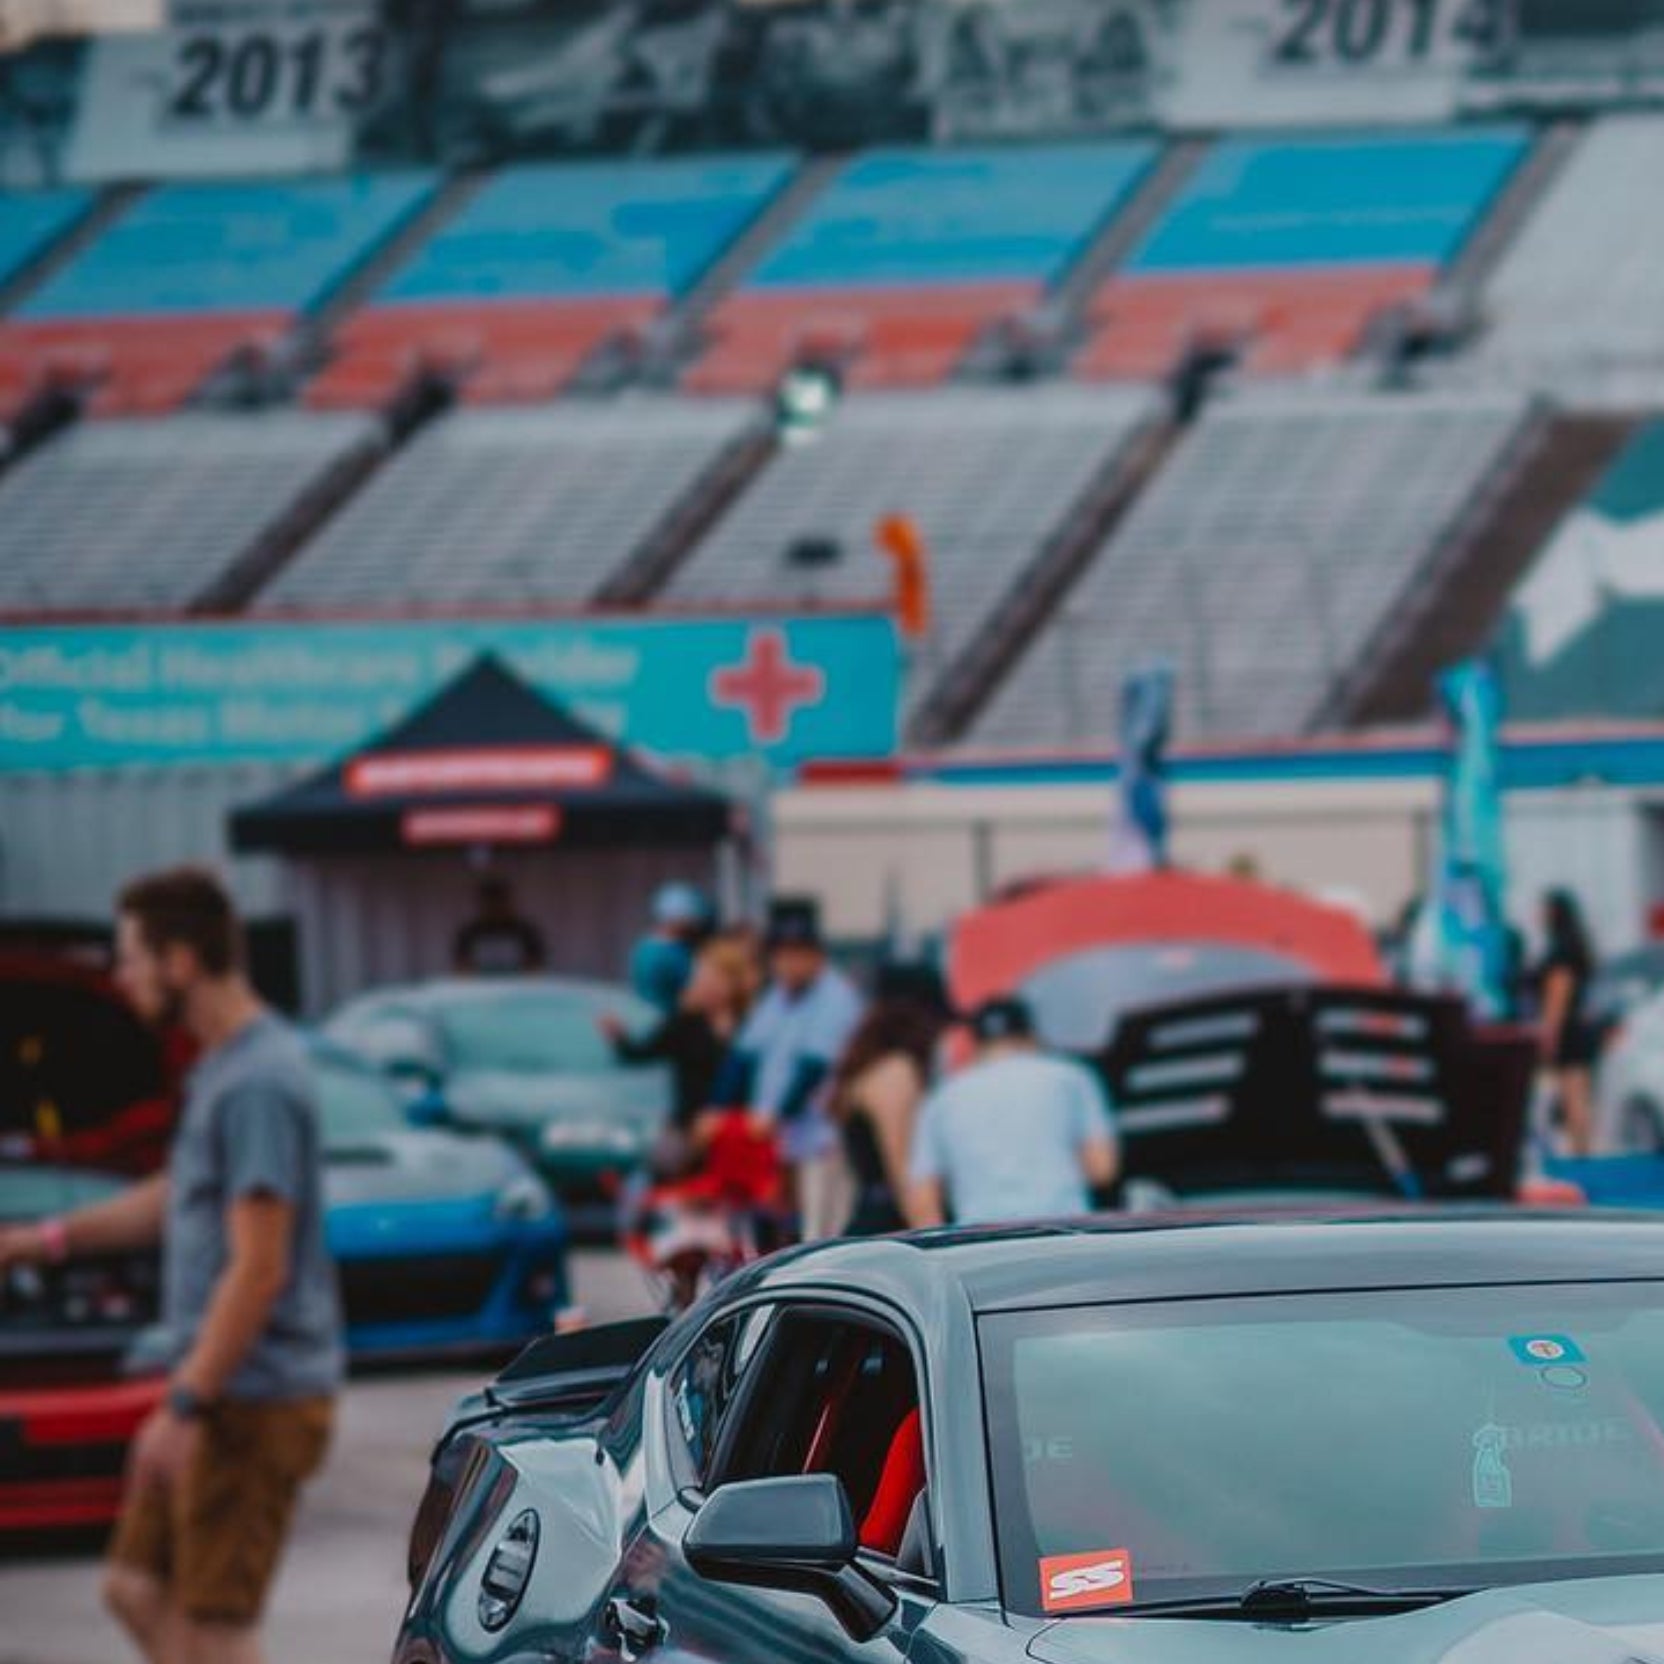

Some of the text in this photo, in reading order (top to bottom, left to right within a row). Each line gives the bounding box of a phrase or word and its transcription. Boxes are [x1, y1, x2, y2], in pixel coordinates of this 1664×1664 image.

[1274, 0, 1502, 64] 2014
[175, 32, 386, 118] 2013
[1050, 1559, 1125, 1600] SS
